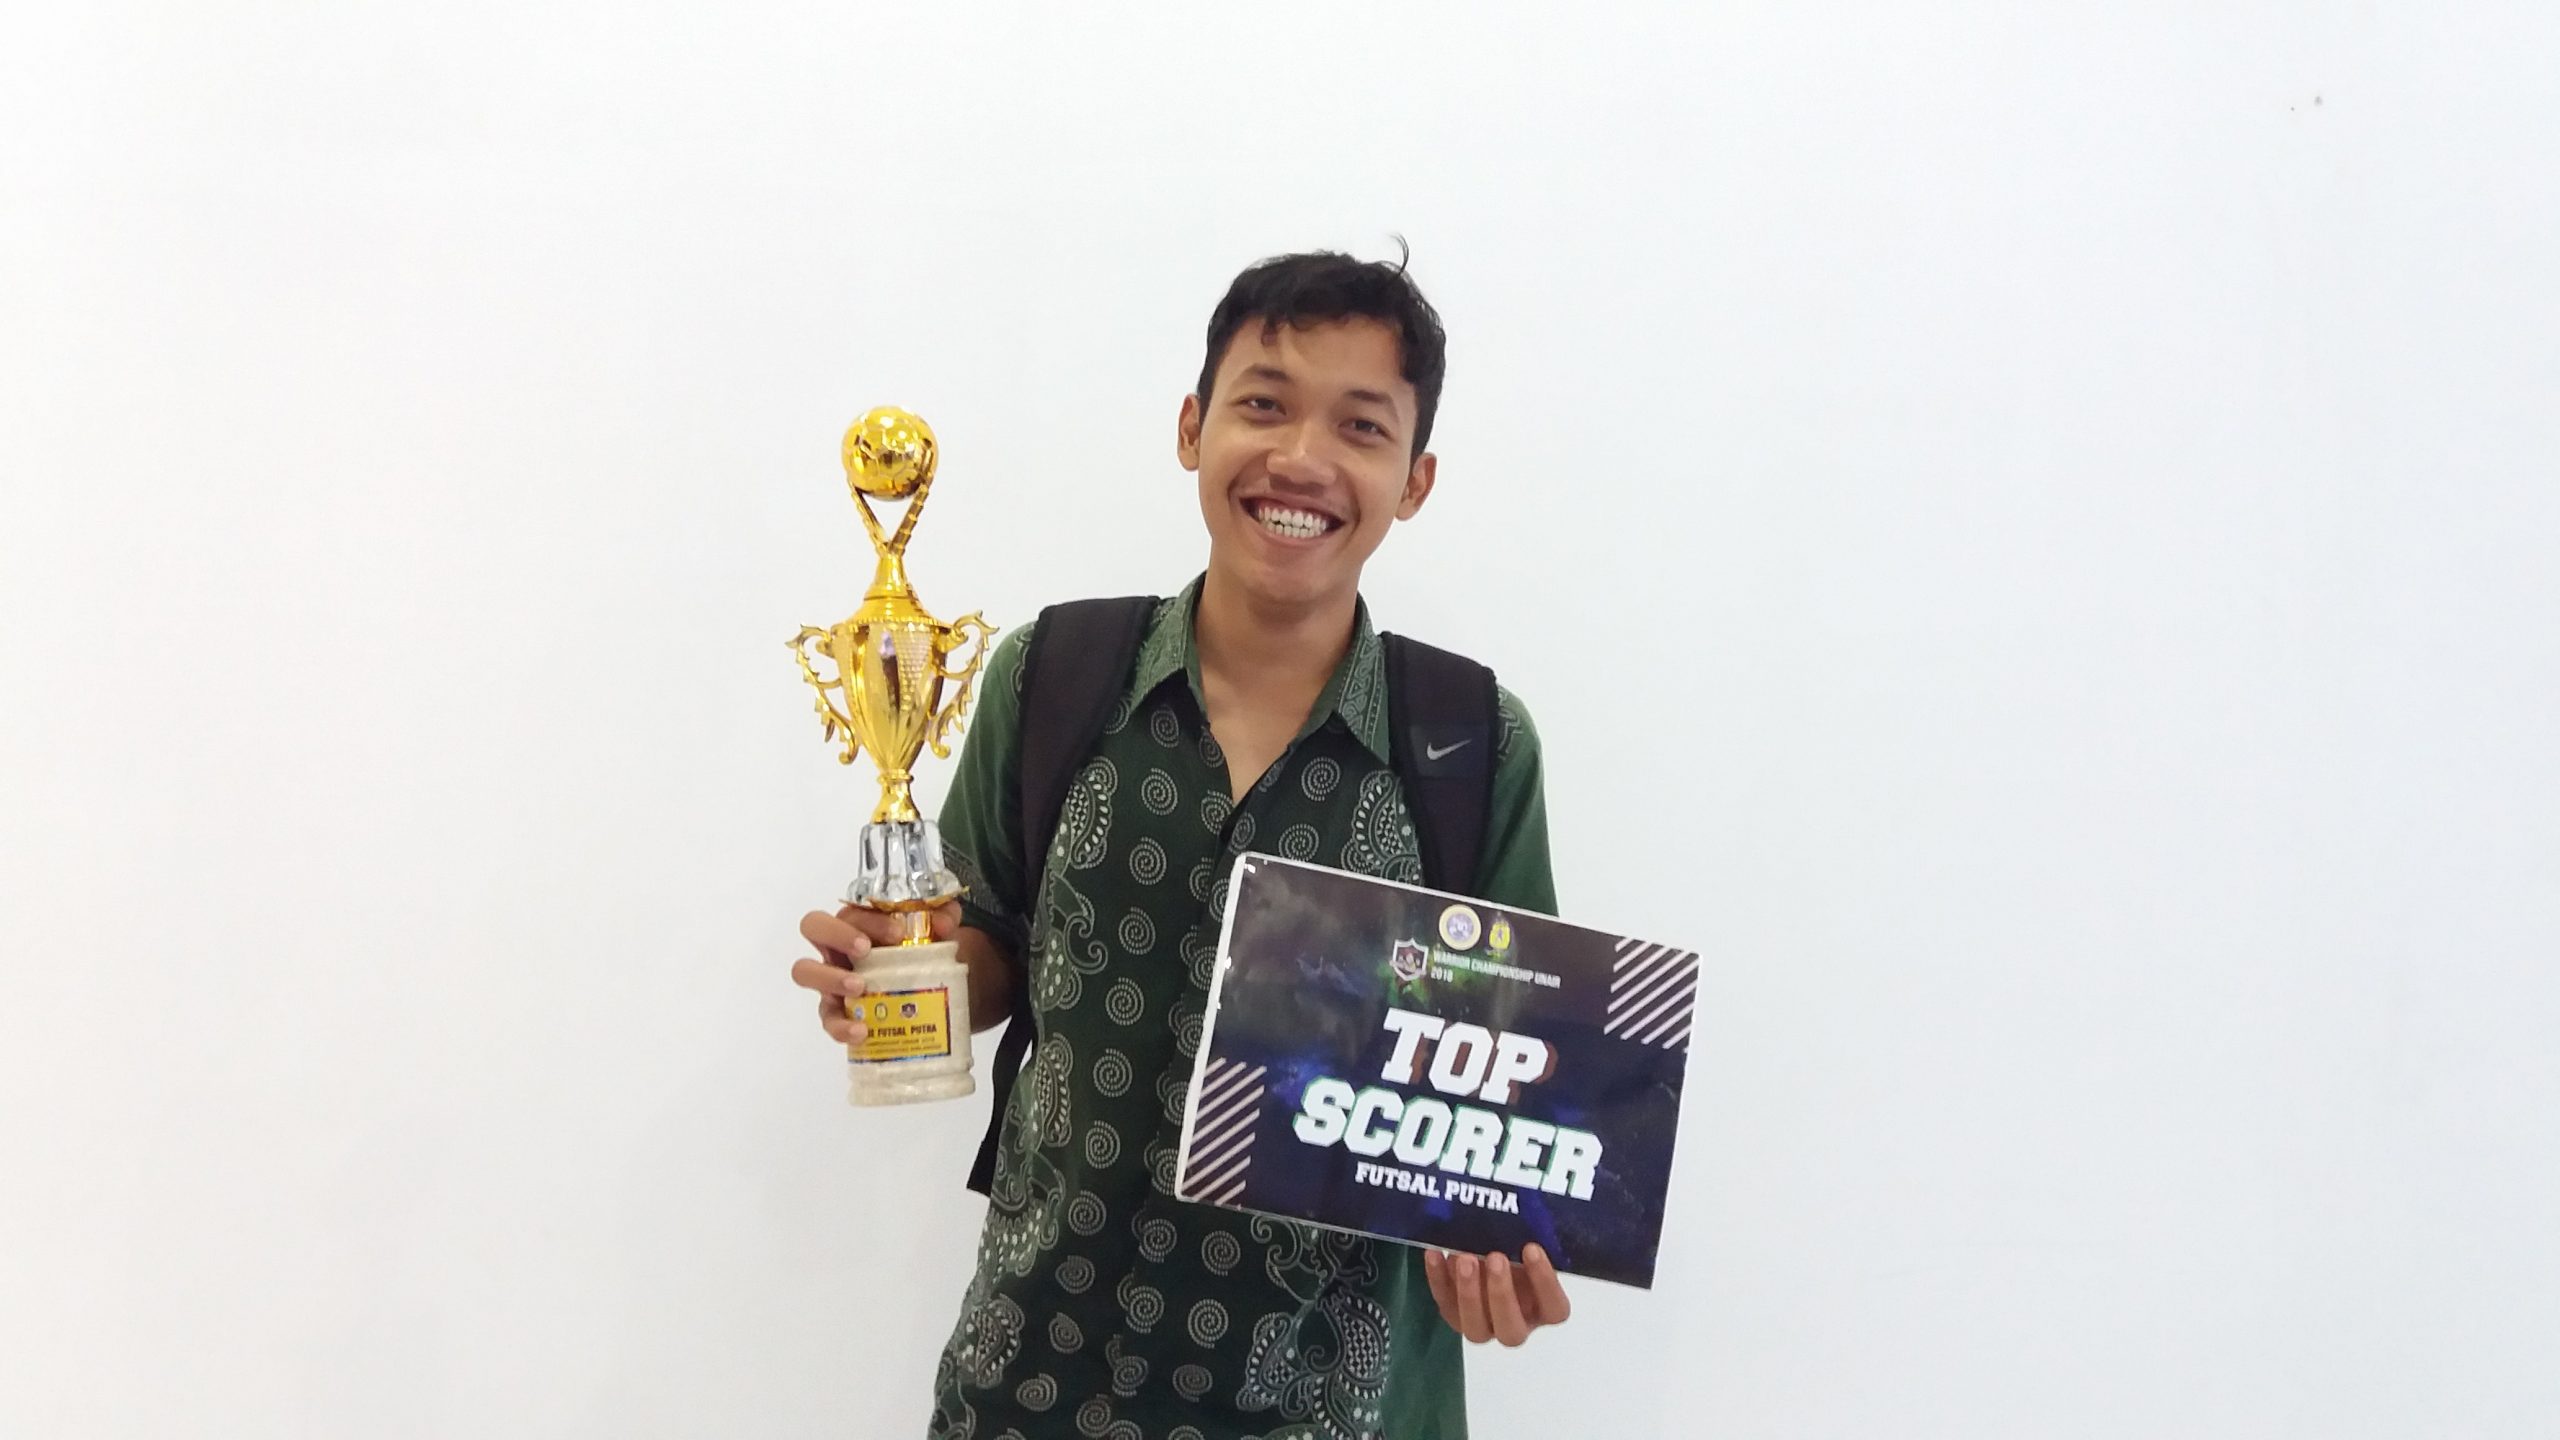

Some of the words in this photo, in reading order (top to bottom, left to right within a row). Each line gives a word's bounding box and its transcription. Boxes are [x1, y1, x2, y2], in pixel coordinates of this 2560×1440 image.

[1471, 958, 1534, 983] CHAMPIONSHIP
[1534, 971, 1562, 990] UNAIR
[878, 1027, 906, 1038] FUTSAL
[911, 1024, 937, 1035] PUTRA
[1381, 1007, 1551, 1105] TOP
[1292, 1075, 1604, 1202] SCORER
[1355, 1161, 1441, 1199] FUTSAL
[1444, 1180, 1520, 1214] PUTRA
